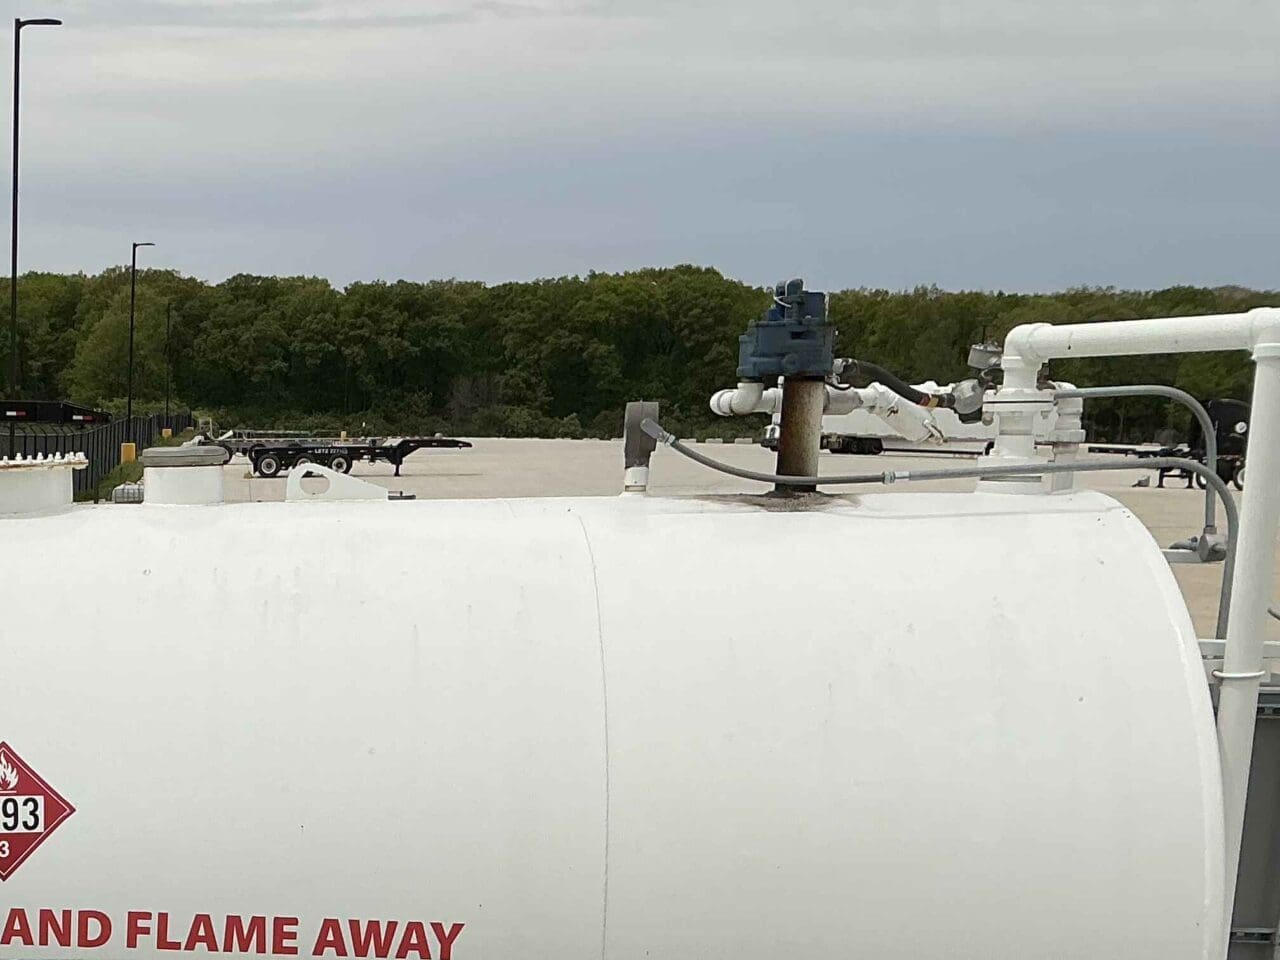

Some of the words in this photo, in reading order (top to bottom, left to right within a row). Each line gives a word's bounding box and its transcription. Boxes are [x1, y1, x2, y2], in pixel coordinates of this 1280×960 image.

[1, 908, 113, 948] AND
[126, 911, 299, 956] FLAME
[313, 919, 464, 960] AWAY
